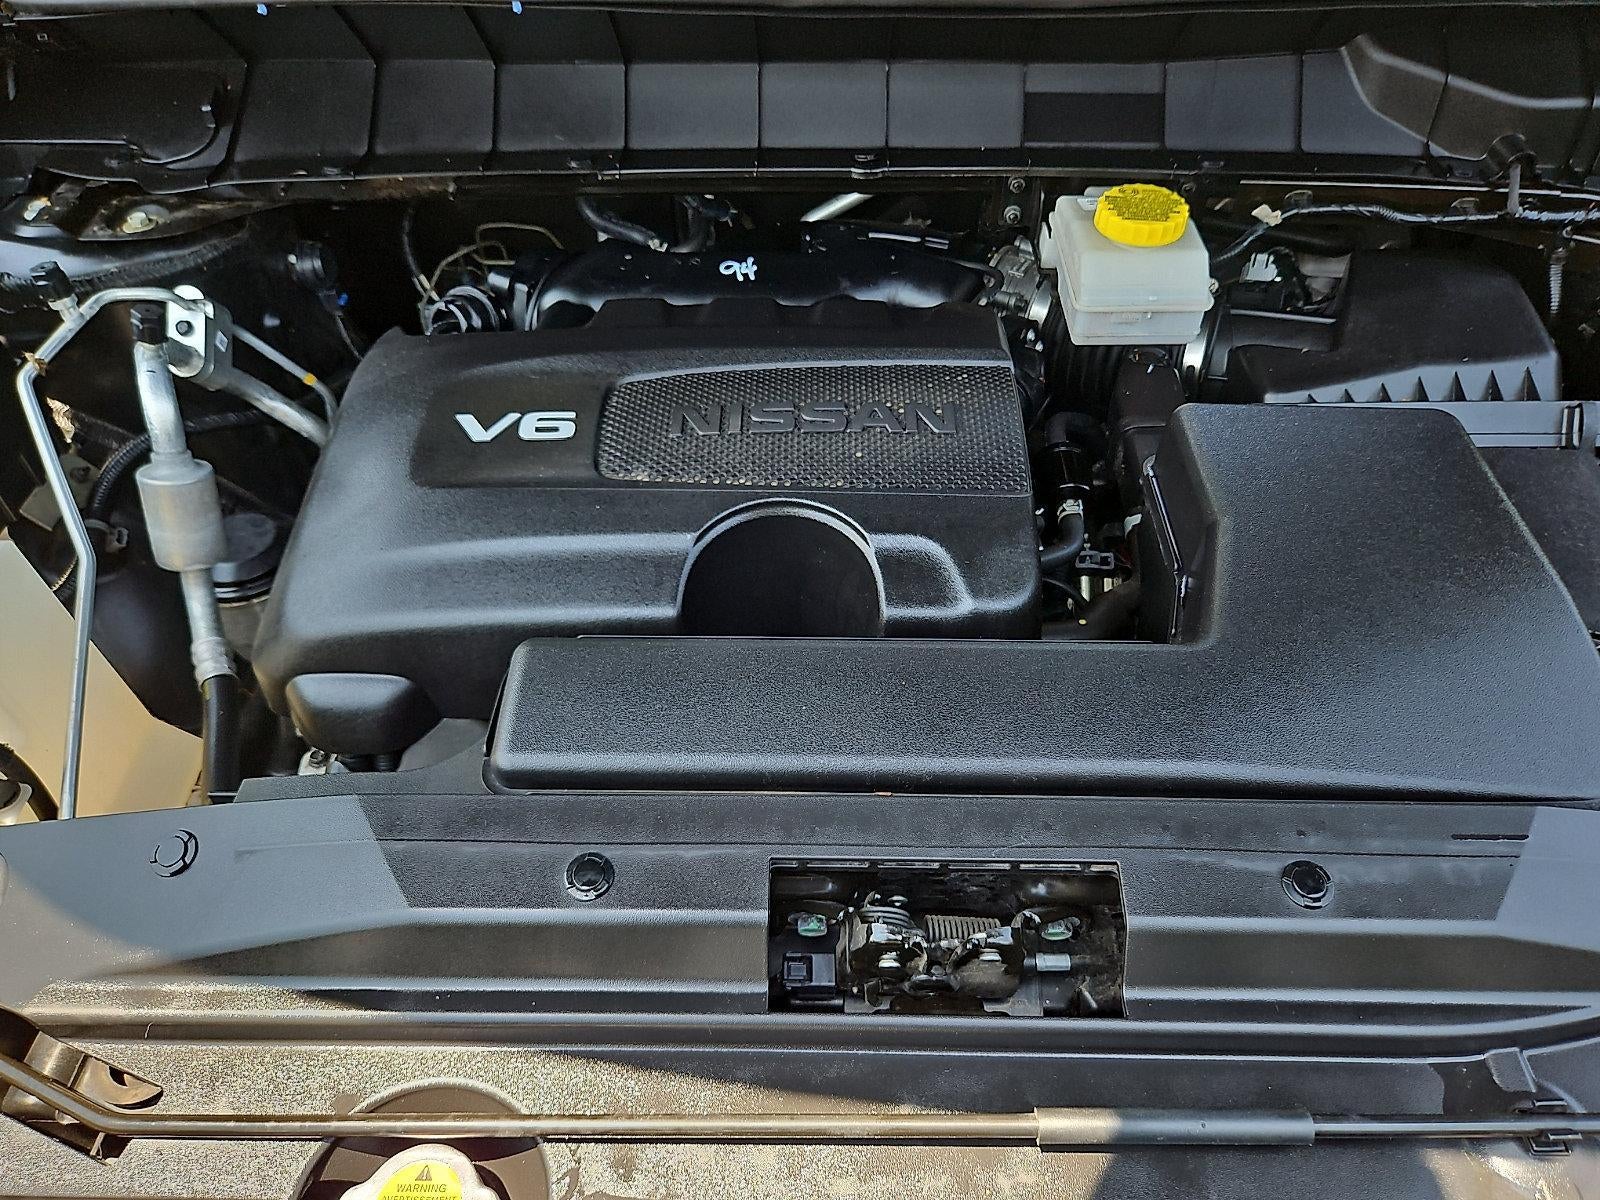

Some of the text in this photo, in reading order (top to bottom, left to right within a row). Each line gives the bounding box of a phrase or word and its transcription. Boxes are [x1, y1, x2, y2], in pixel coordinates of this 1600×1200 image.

[719, 256, 757, 281] 94
[453, 411, 577, 442] V6
[669, 401, 957, 436] NISSAN
[396, 1183, 448, 1193] WARNING
